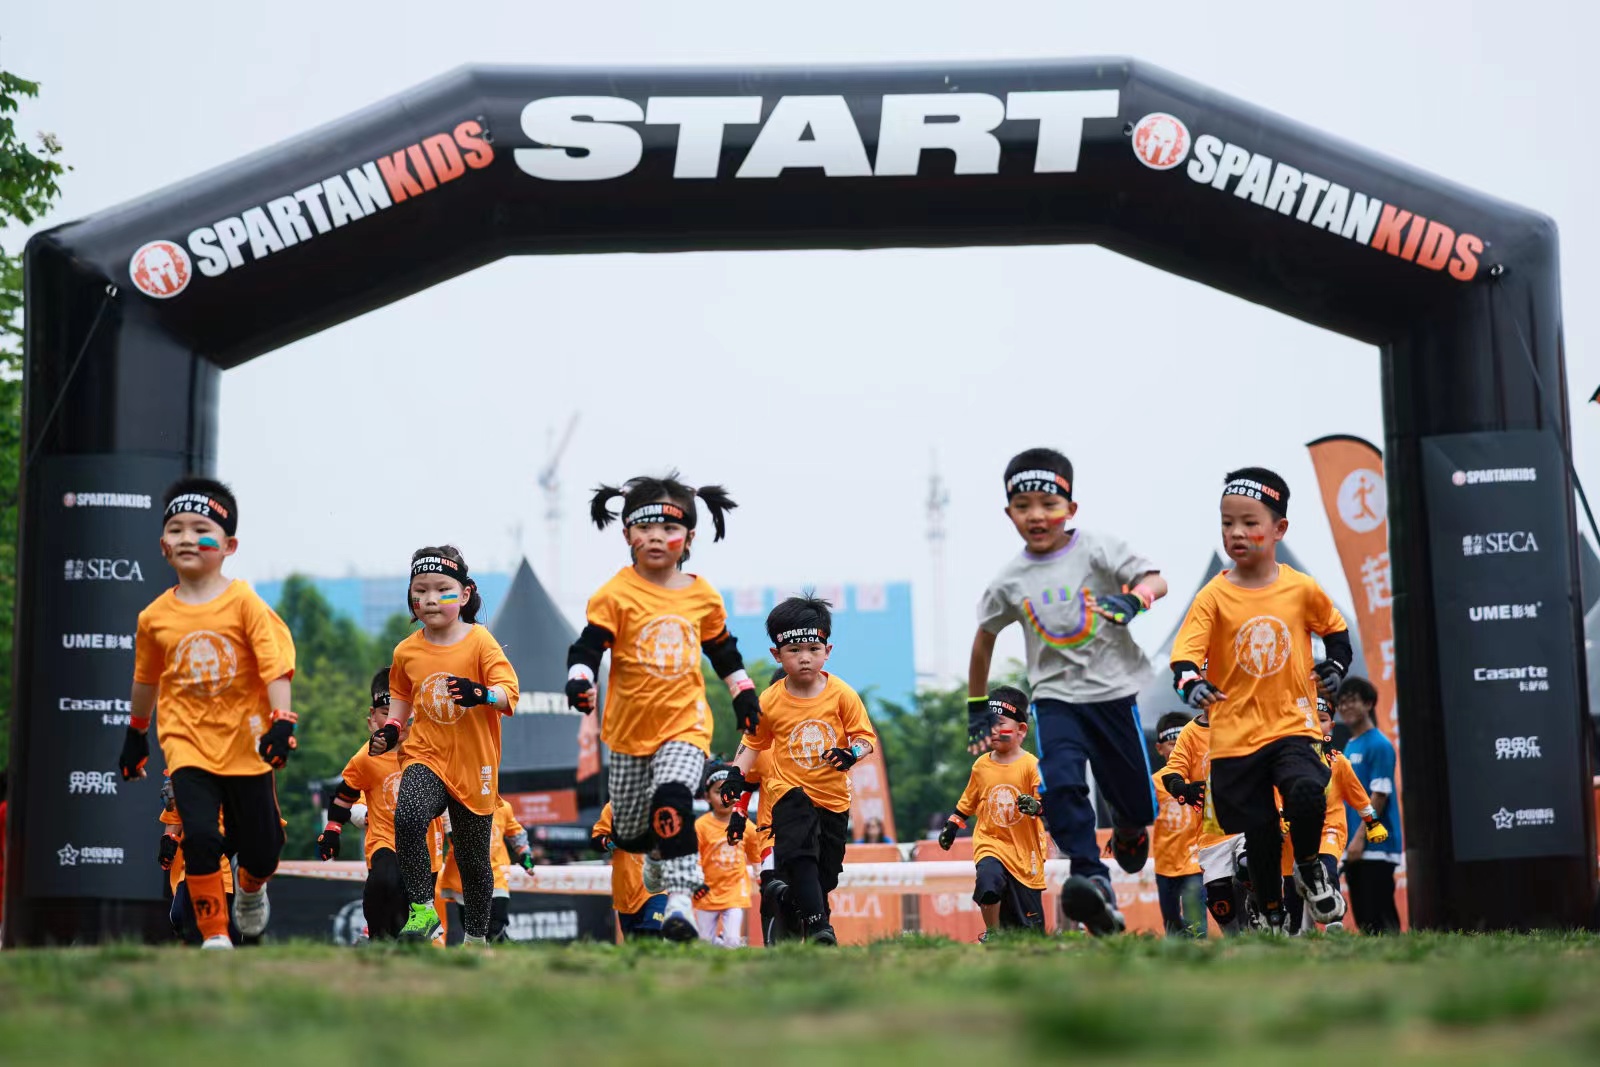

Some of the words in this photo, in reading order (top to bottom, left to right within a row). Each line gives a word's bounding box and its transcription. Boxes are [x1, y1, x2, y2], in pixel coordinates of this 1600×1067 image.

[513, 89, 1120, 182] START
[188, 119, 494, 278] SPARTANKIDS
[1187, 134, 1485, 282] SPARTANKIDS
[171, 501, 210, 516] 17642
[1486, 531, 1539, 553] SECA
[87, 558, 144, 581] SECA
[414, 563, 443, 575] 17804
[1474, 666, 1548, 681] Casarte
[59, 698, 132, 711] Casarte
